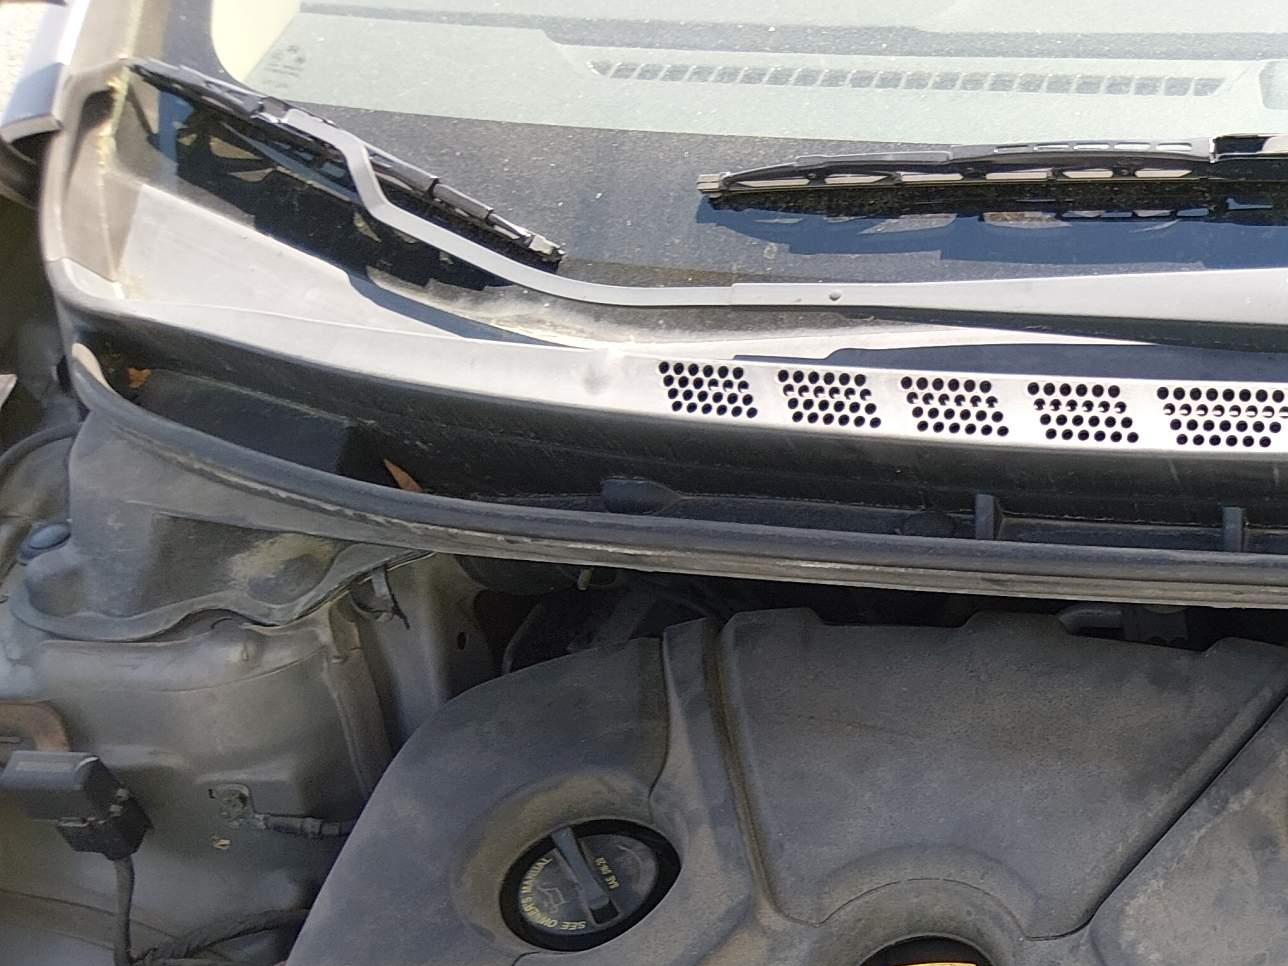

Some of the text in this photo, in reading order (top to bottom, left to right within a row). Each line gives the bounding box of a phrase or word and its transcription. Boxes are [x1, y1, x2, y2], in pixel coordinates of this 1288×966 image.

[520, 856, 587, 931] SEE OWNER'S MANUAL
